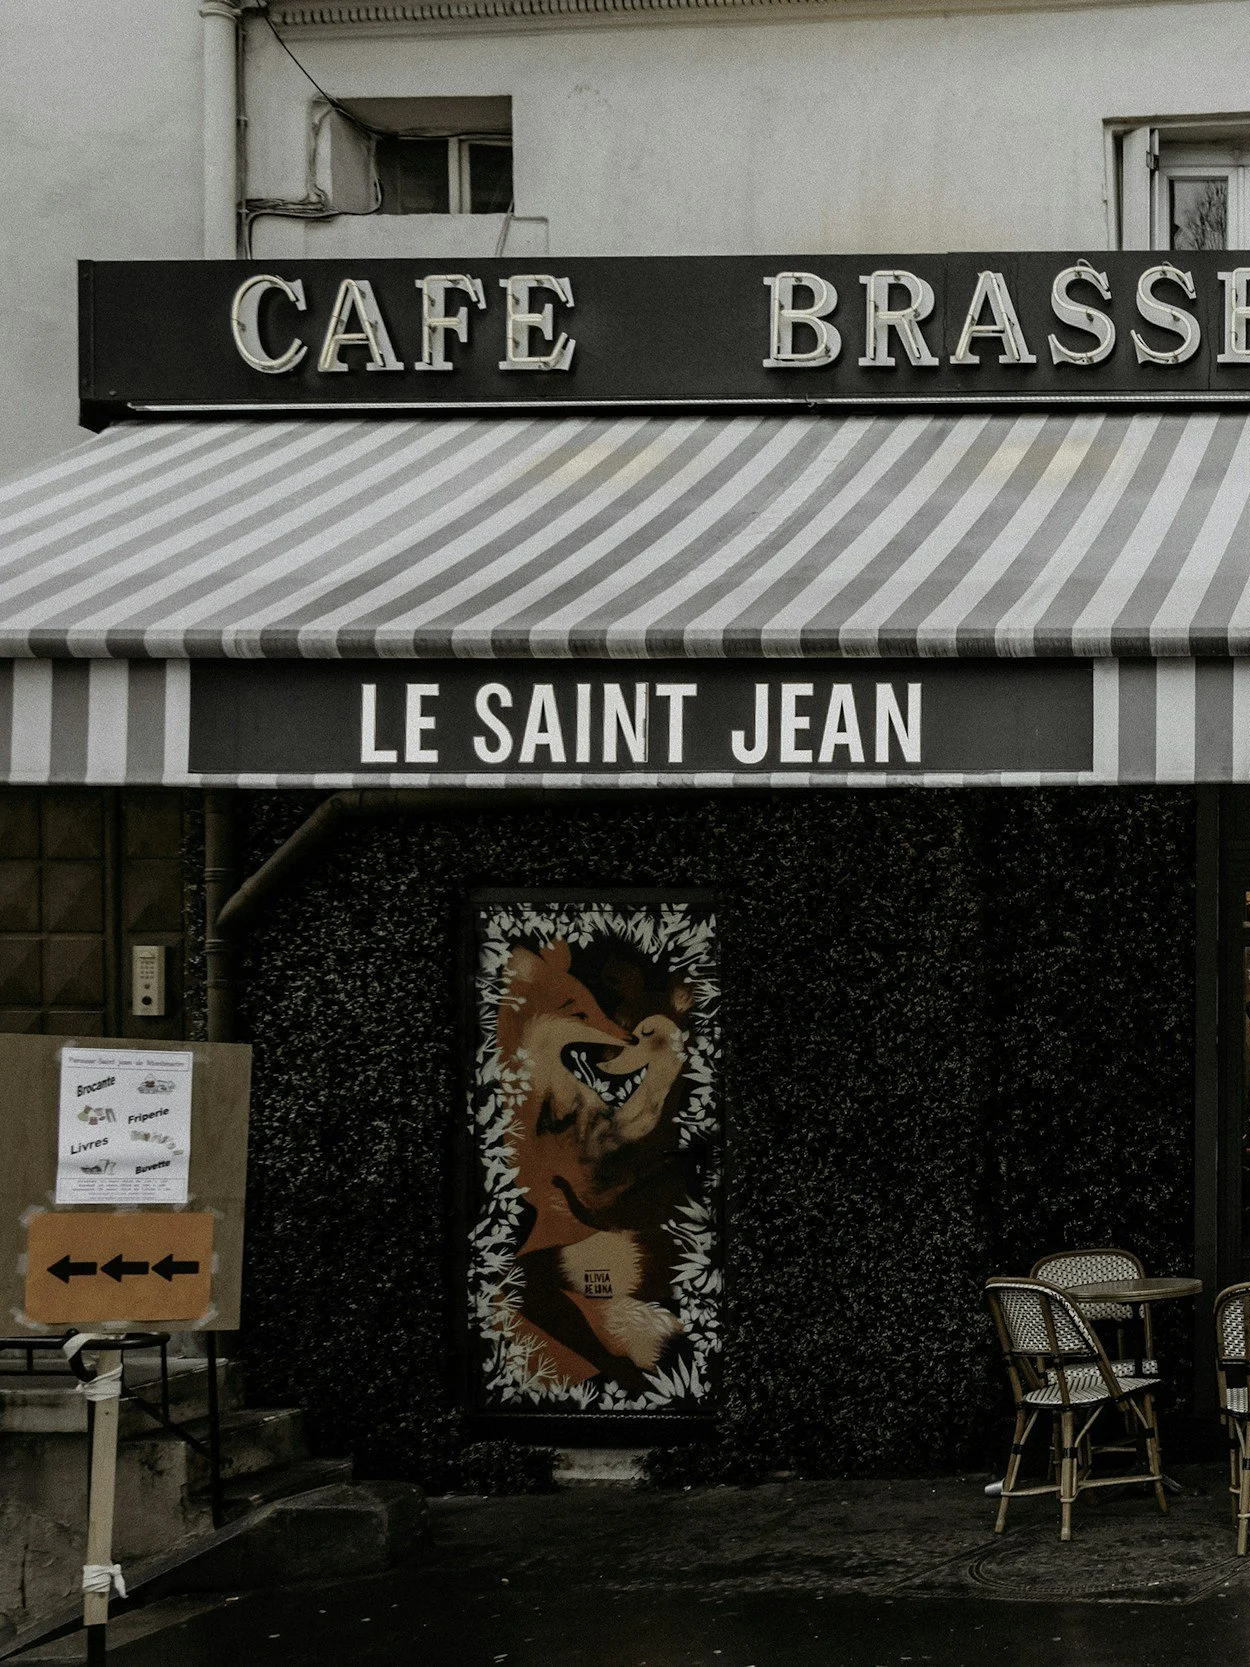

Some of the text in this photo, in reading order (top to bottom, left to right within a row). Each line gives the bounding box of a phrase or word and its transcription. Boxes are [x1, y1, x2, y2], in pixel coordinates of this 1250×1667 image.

[231, 274, 576, 374] CAFE
[360, 682, 923, 764] LE SAINT JEAN
[77, 1076, 116, 1098] Brocante
[127, 1107, 170, 1125] Friperie
[70, 1137, 109, 1155] Livres
[135, 1160, 171, 1175] Buvette
[584, 1272, 611, 1283] OLIVIA
